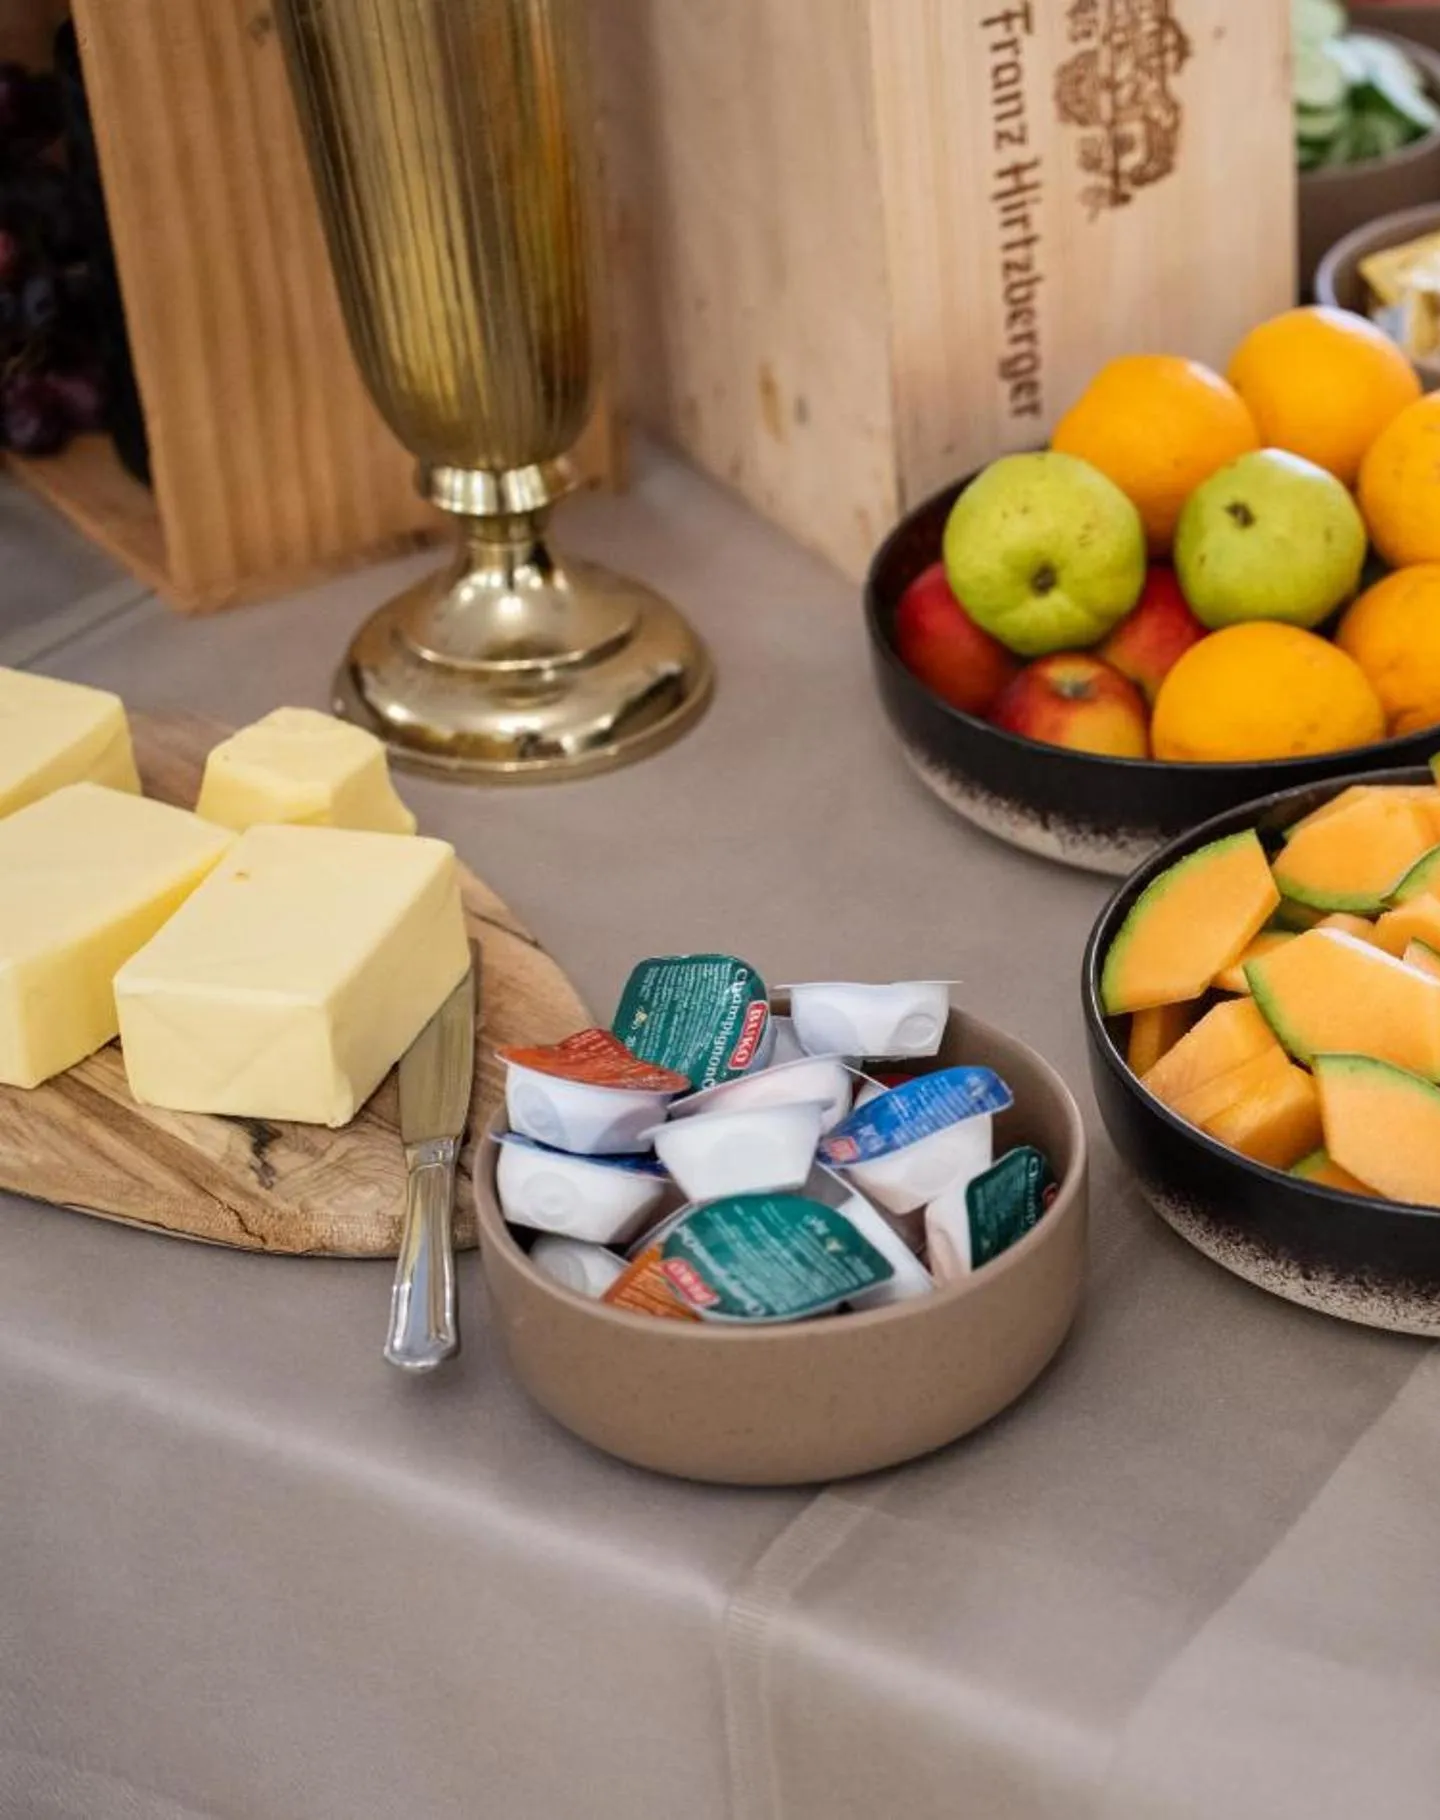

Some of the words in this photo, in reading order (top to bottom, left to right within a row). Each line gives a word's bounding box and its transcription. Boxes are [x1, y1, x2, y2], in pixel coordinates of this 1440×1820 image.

[980, 0, 1034, 151] Franz
[991, 157, 1044, 419] Hirtzberger
[735, 1008, 762, 1063] BUKO
